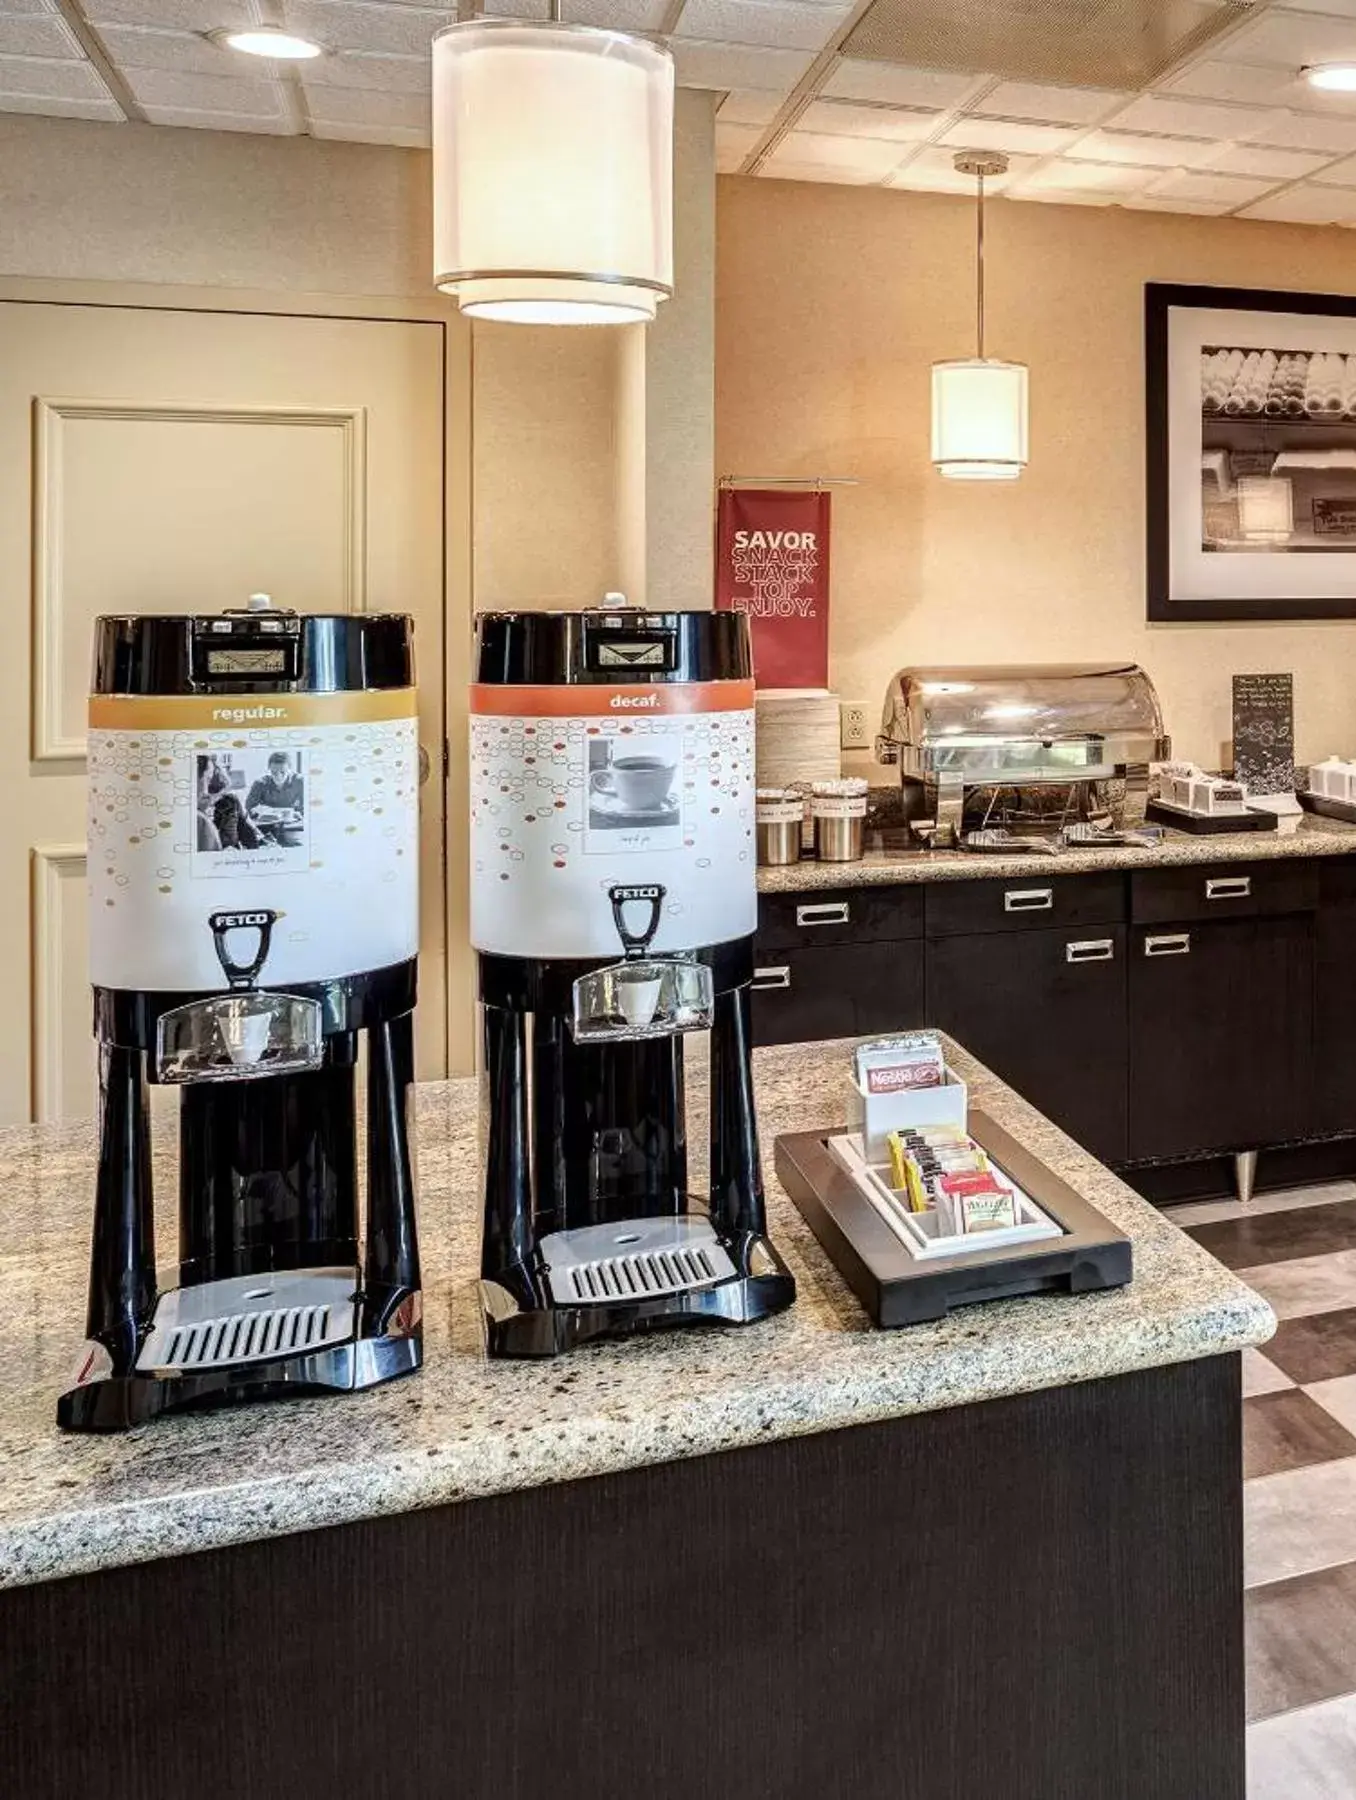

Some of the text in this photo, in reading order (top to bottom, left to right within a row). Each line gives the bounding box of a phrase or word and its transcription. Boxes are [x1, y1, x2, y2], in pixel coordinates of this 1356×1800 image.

[735, 531, 815, 548] SAVOR
[732, 547, 818, 566] SNACK
[735, 564, 813, 583] STACK
[750, 581, 799, 599] TOP
[610, 694, 660, 708] decaf.
[213, 705, 288, 723] regular.
[614, 888, 659, 899] FETCO
[215, 913, 268, 927] FETCO
